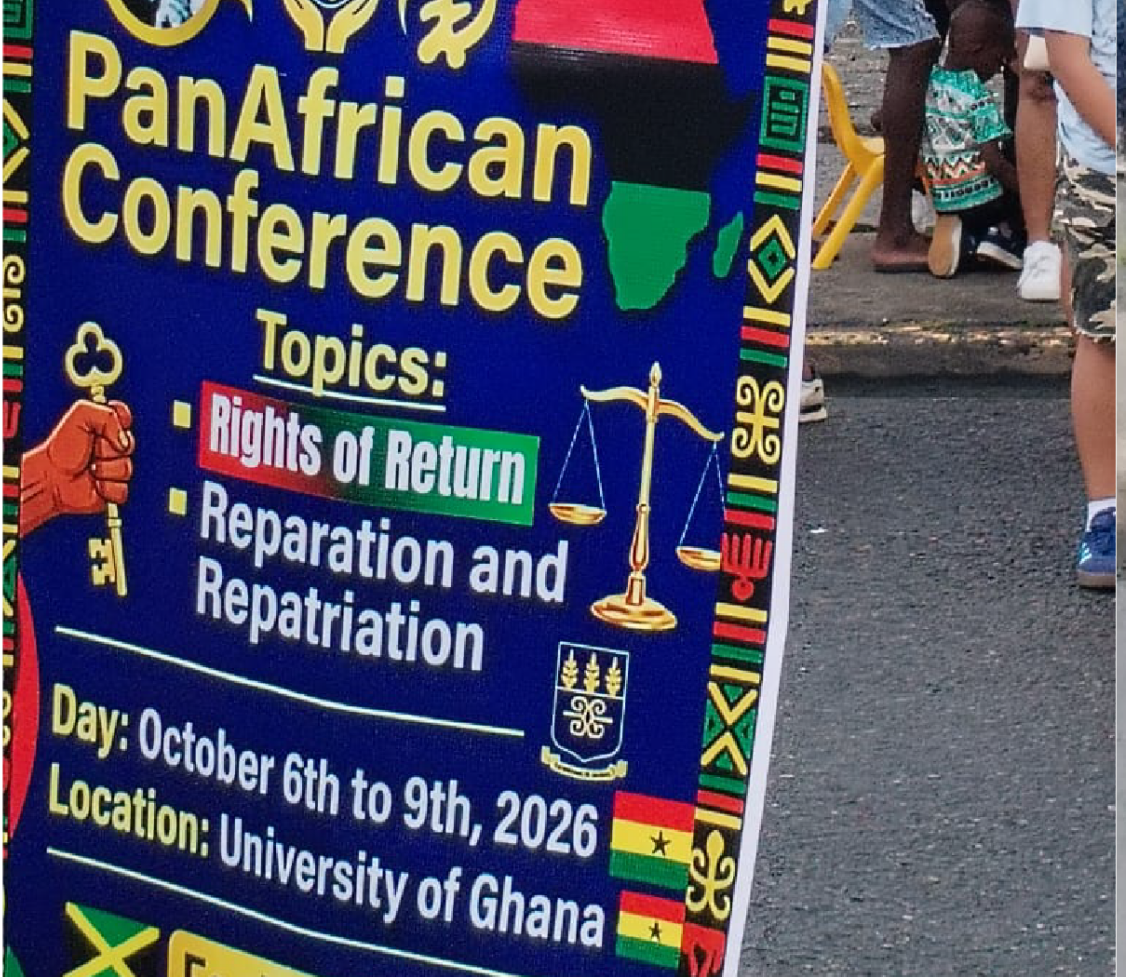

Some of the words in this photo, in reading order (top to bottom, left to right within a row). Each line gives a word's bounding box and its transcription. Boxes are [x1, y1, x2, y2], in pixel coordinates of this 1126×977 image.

[65, 30, 592, 206] PanAfrican
[62, 142, 584, 320] Conference
[254, 309, 447, 398] Topics:
[208, 393, 323, 476] Rights
[332, 433, 375, 485] of
[385, 429, 526, 505] Return
[196, 557, 485, 671] Repatriation
[200, 481, 455, 590] Reparation
[469, 540, 569, 604] and
[52, 683, 130, 758] Day:
[138, 707, 276, 792] October
[282, 756, 342, 818] 6th
[351, 769, 393, 824] to
[402, 777, 485, 846] 9th,
[494, 798, 599, 858] 2026
[48, 762, 210, 858] Location:
[219, 814, 408, 924] University
[417, 868, 462, 921] of
[469, 873, 606, 948] Ghana
